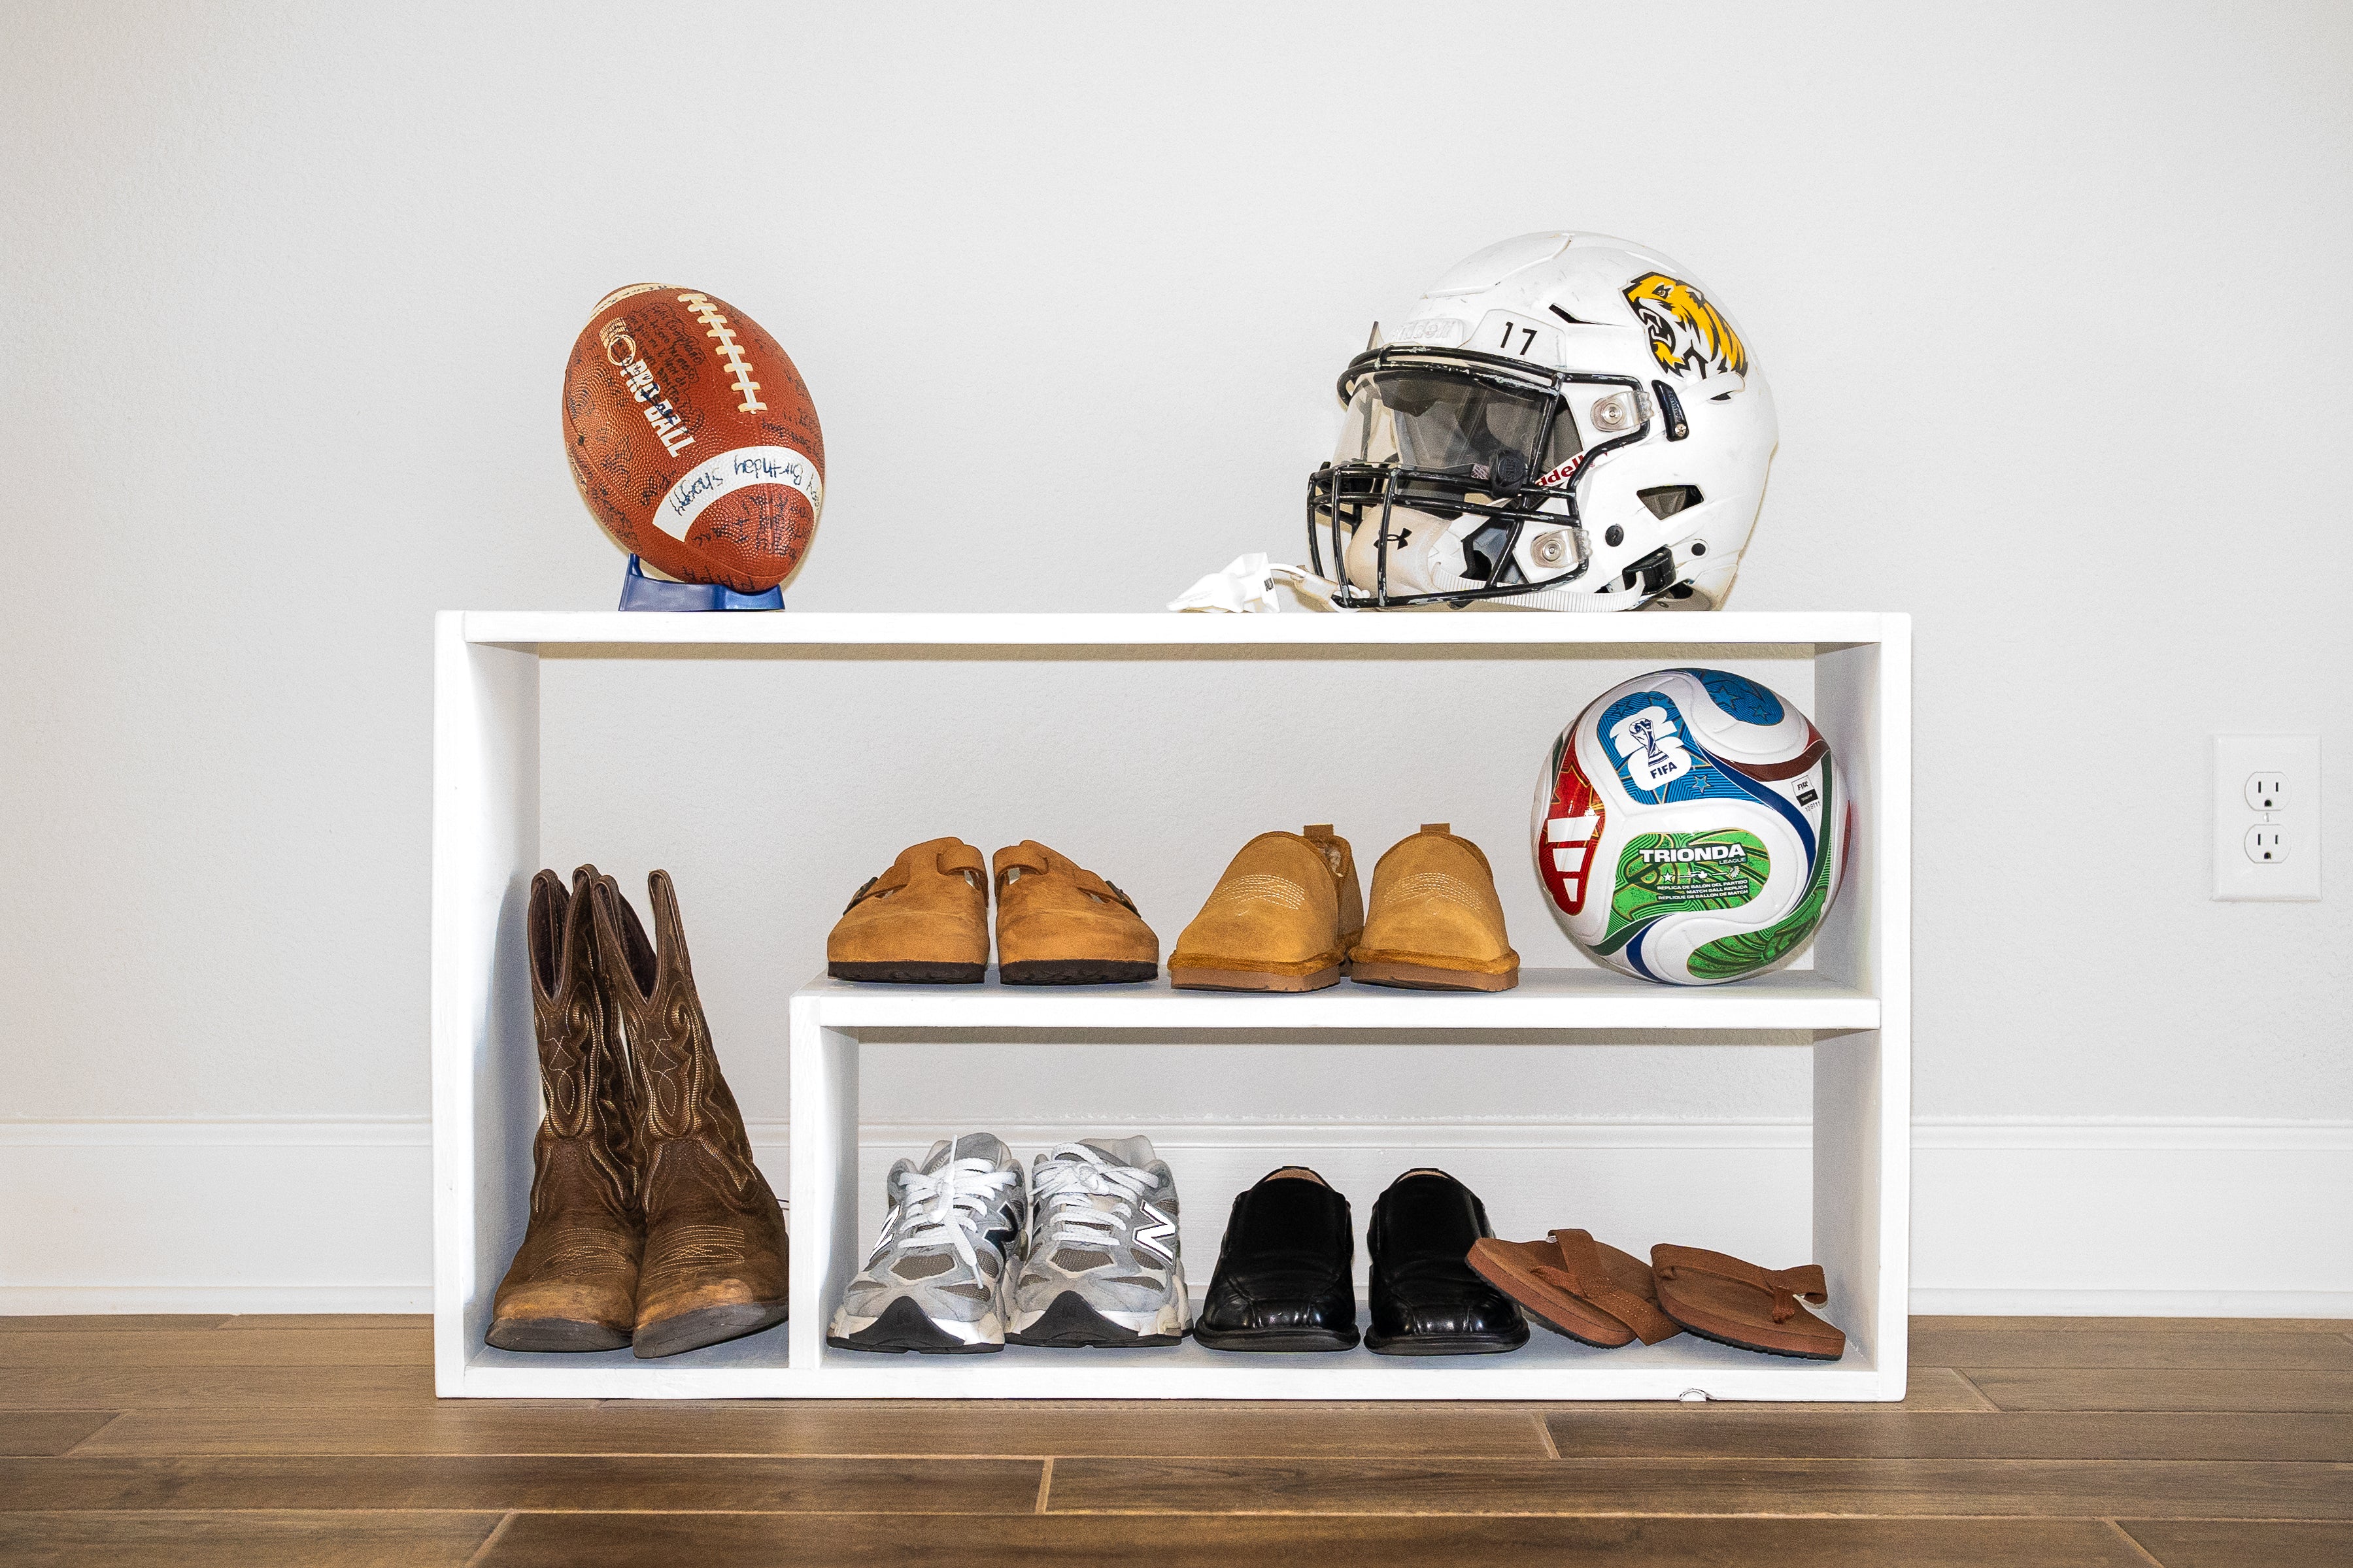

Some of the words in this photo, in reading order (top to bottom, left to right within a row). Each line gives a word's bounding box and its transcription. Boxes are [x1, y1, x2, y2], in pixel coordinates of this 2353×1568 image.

[1500, 321, 1538, 356] 17
[620, 358, 661, 403] PRO
[643, 398, 696, 458] BALL
[733, 453, 804, 486] Birthday
[1650, 761, 1678, 779] FIFA
[1638, 844, 1746, 863] TRIONDA
